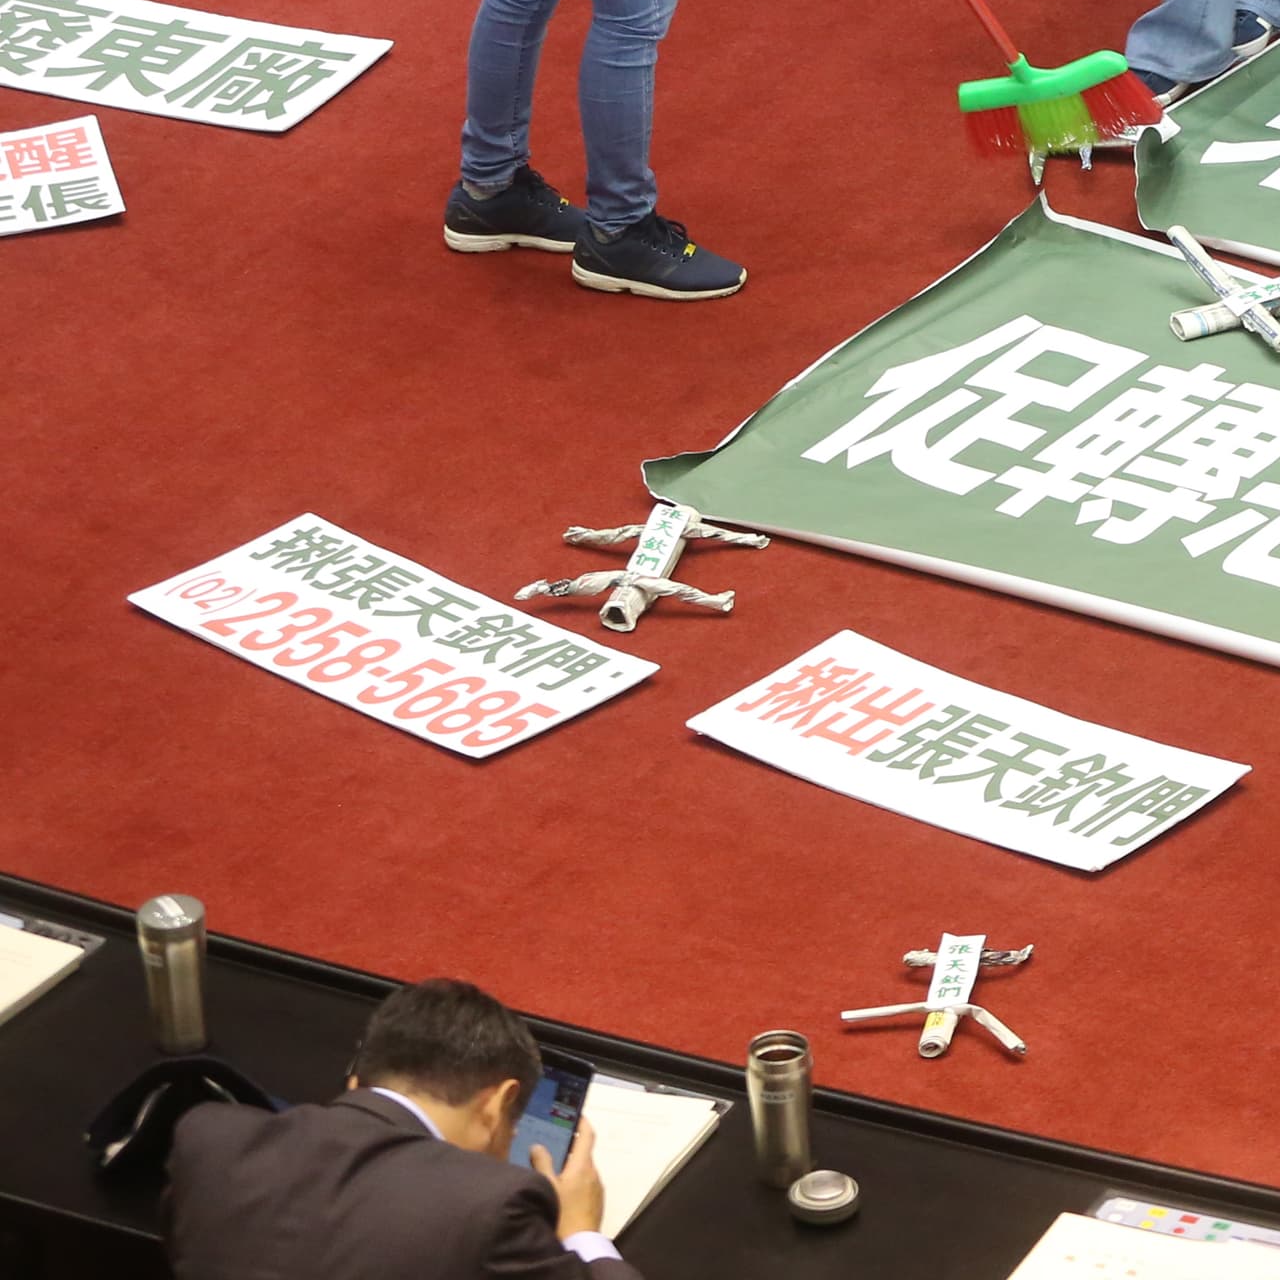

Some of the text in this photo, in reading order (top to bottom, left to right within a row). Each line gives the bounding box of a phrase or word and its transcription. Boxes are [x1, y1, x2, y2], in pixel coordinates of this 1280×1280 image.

[0, 126, 98, 181] 醒
[164, 570, 560, 748] (02)2358-5685
[734, 657, 1210, 847] 揪出張天欽們
